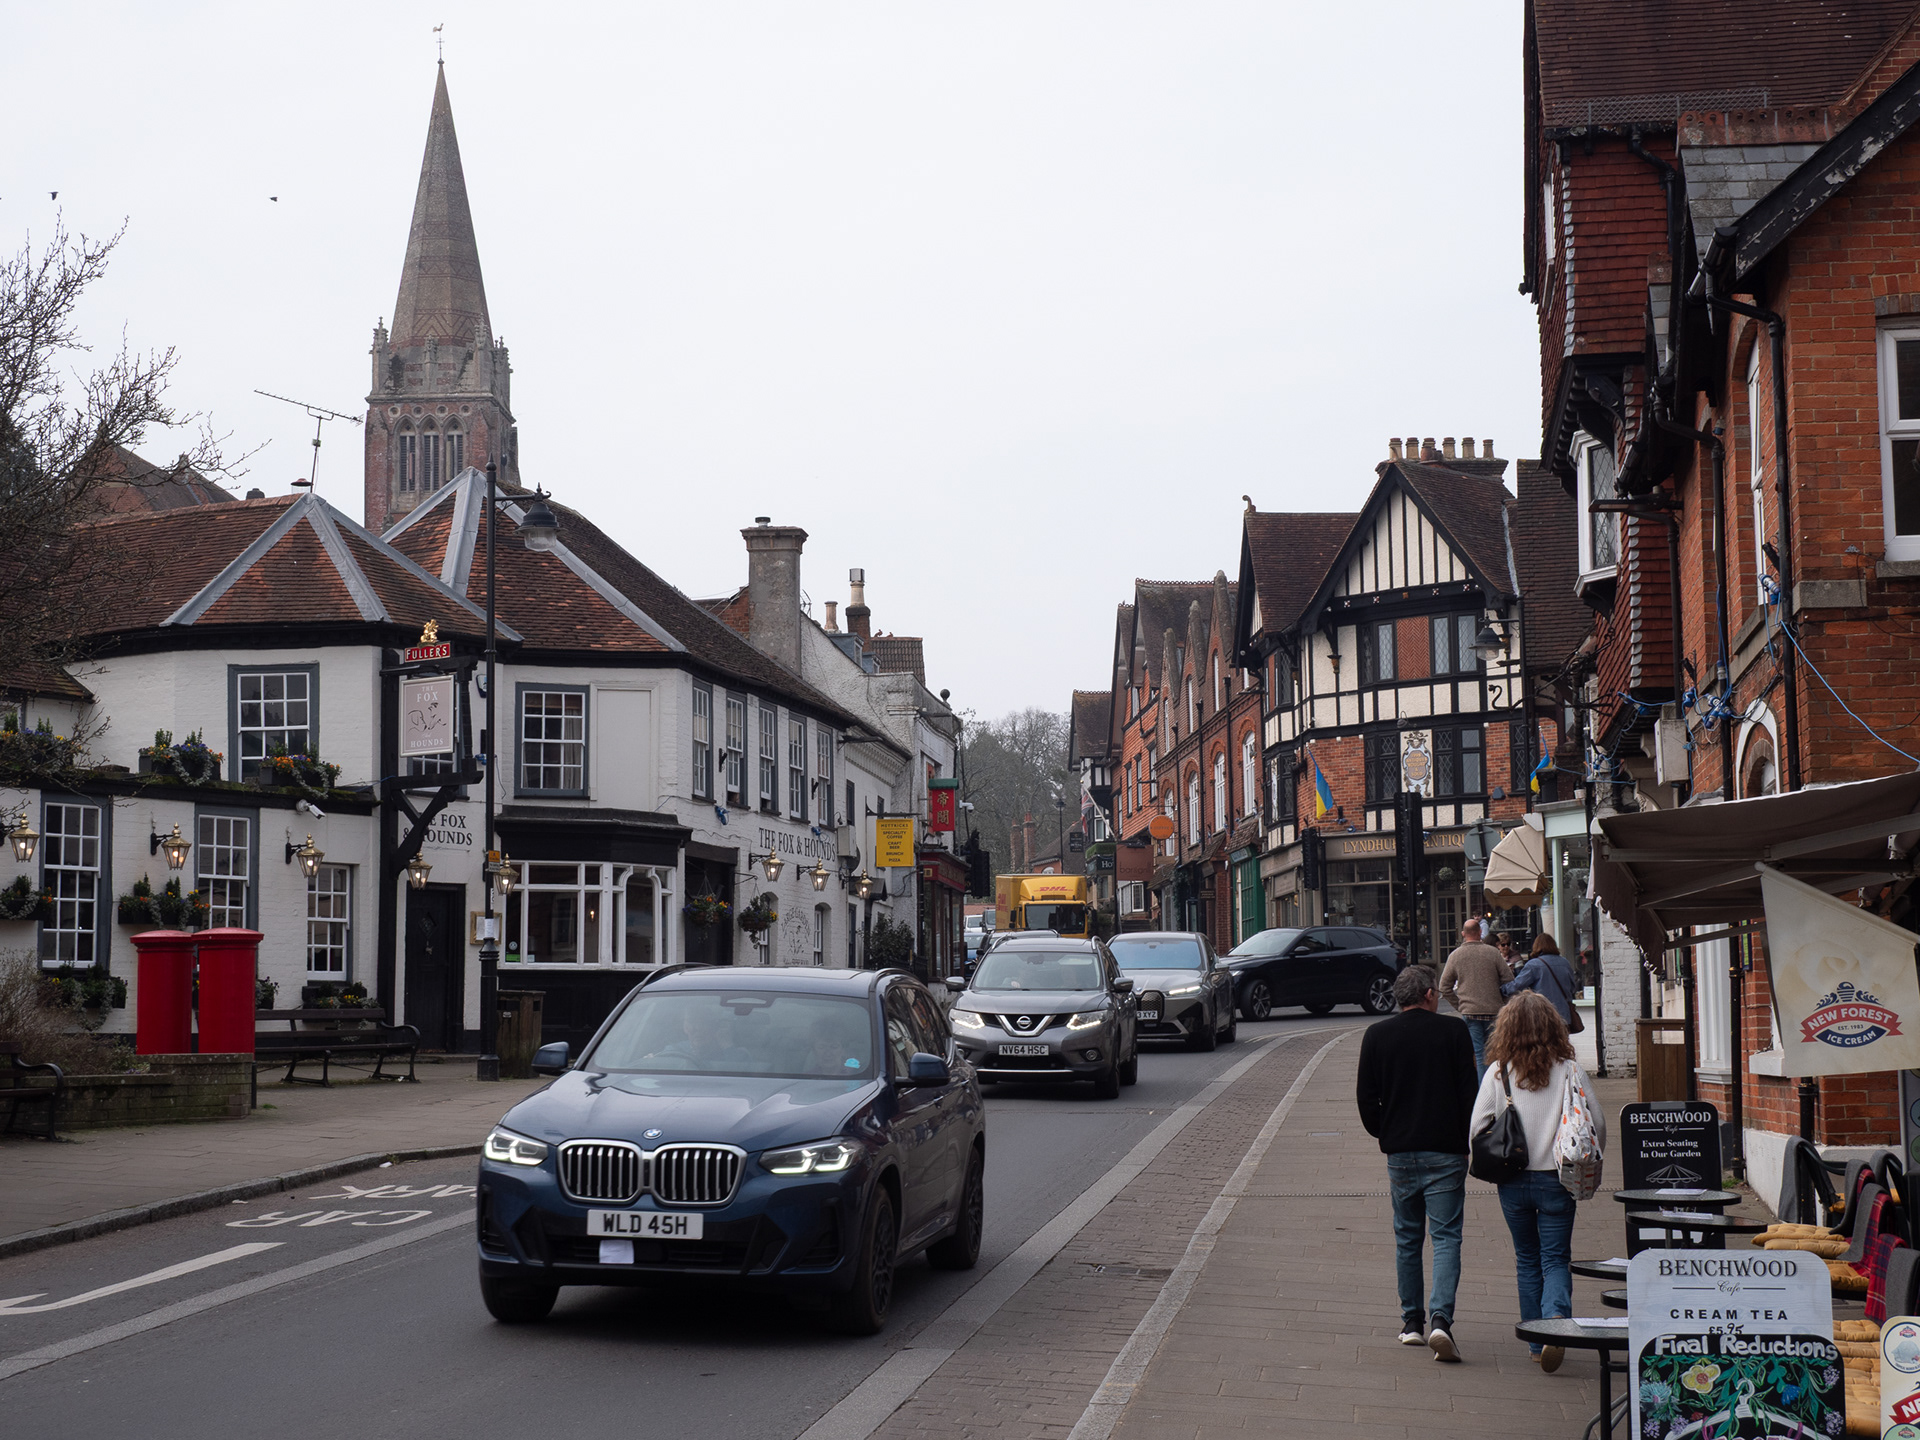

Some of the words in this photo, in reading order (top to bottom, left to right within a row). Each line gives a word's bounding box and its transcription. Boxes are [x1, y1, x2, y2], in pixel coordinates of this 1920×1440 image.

[406, 646, 447, 660] FULLER'S
[416, 692, 439, 702] FOX
[410, 739, 444, 748] HOUNDS
[440, 814, 467, 829] FOX
[424, 829, 472, 846] OUNDS
[759, 827, 776, 850] THE
[778, 831, 794, 854] FOX
[796, 836, 802, 855] &
[804, 837, 836, 862] HOUNDS
[1807, 1010, 1837, 1030] NEW
[1840, 1007, 1892, 1024] FOREST
[1826, 1033, 1842, 1044] ICE
[1844, 1030, 1877, 1045] CREAM
[1002, 1046, 1026, 1055] NV64
[1028, 1046, 1045, 1055] HSC
[1629, 1110, 1712, 1124] BENCHWOOD
[1642, 1140, 1665, 1148] Extra
[1667, 1139, 1698, 1148] Seating
[1640, 1150, 1649, 1158] In
[1651, 1150, 1668, 1158] Our
[1670, 1149, 1701, 1157] Garden
[308, 1184, 477, 1200] ARK
[226, 1210, 433, 1228] CAR
[603, 1213, 642, 1233] WLD
[648, 1215, 688, 1235] 45H
[1658, 1257, 1797, 1277] BENCHWOOD
[1717, 1280, 1741, 1296] Cafe
[1670, 1309, 1738, 1320] CREAM
[1750, 1310, 1788, 1320] TEA
[1709, 1322, 1744, 1334] £5.95
[1655, 1334, 1708, 1355] Final
[1720, 1334, 1839, 1361] Reductions
